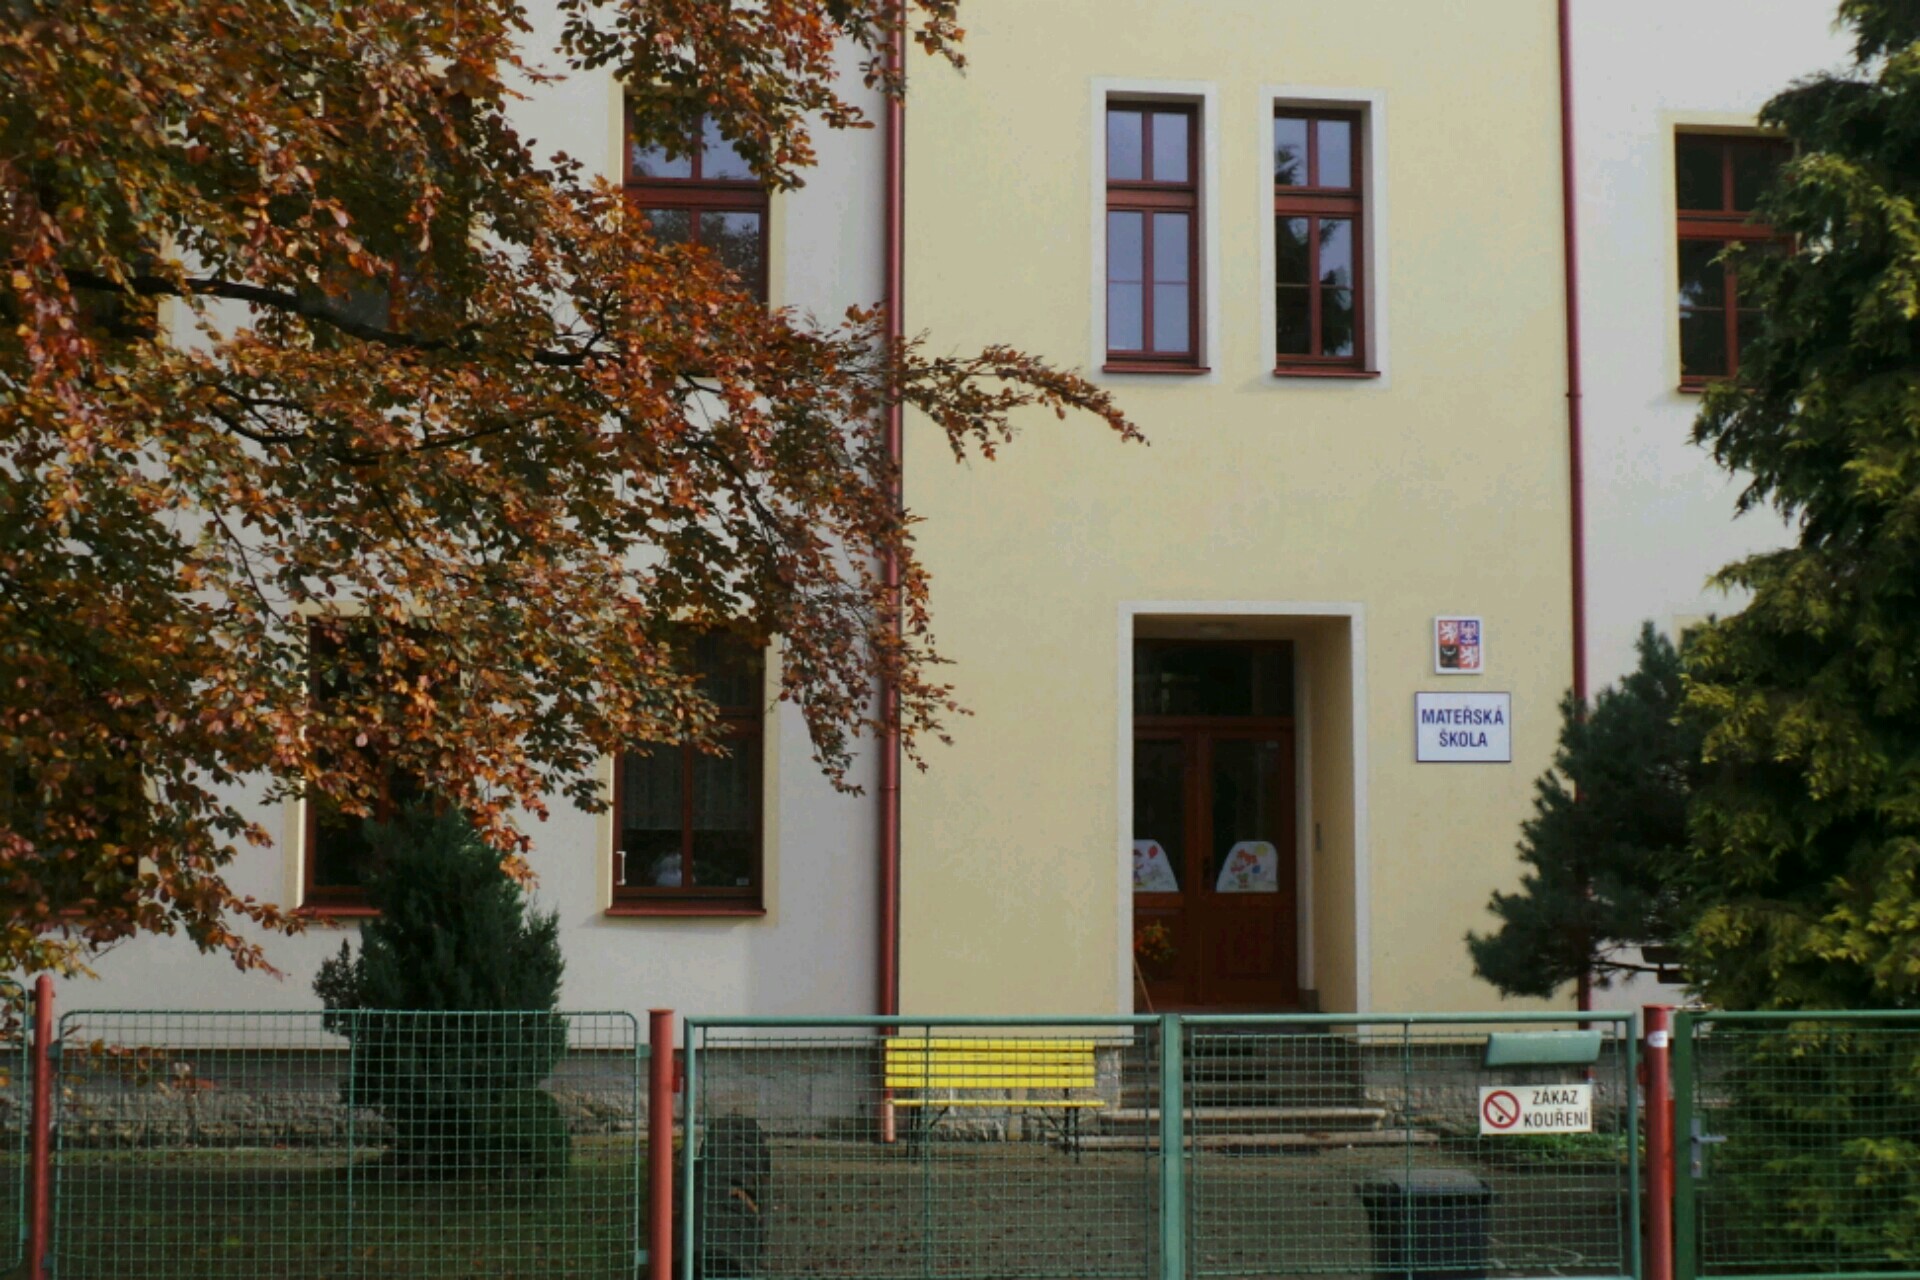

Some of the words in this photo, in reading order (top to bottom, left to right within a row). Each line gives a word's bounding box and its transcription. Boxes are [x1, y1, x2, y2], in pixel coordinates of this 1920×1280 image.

[1421, 706, 1504, 726] MATEŘSKÁ
[1439, 728, 1488, 747] ŠKOLA
[1532, 1088, 1579, 1105] ZÁKAZ
[1523, 1108, 1589, 1128] KOUŘENÍ
